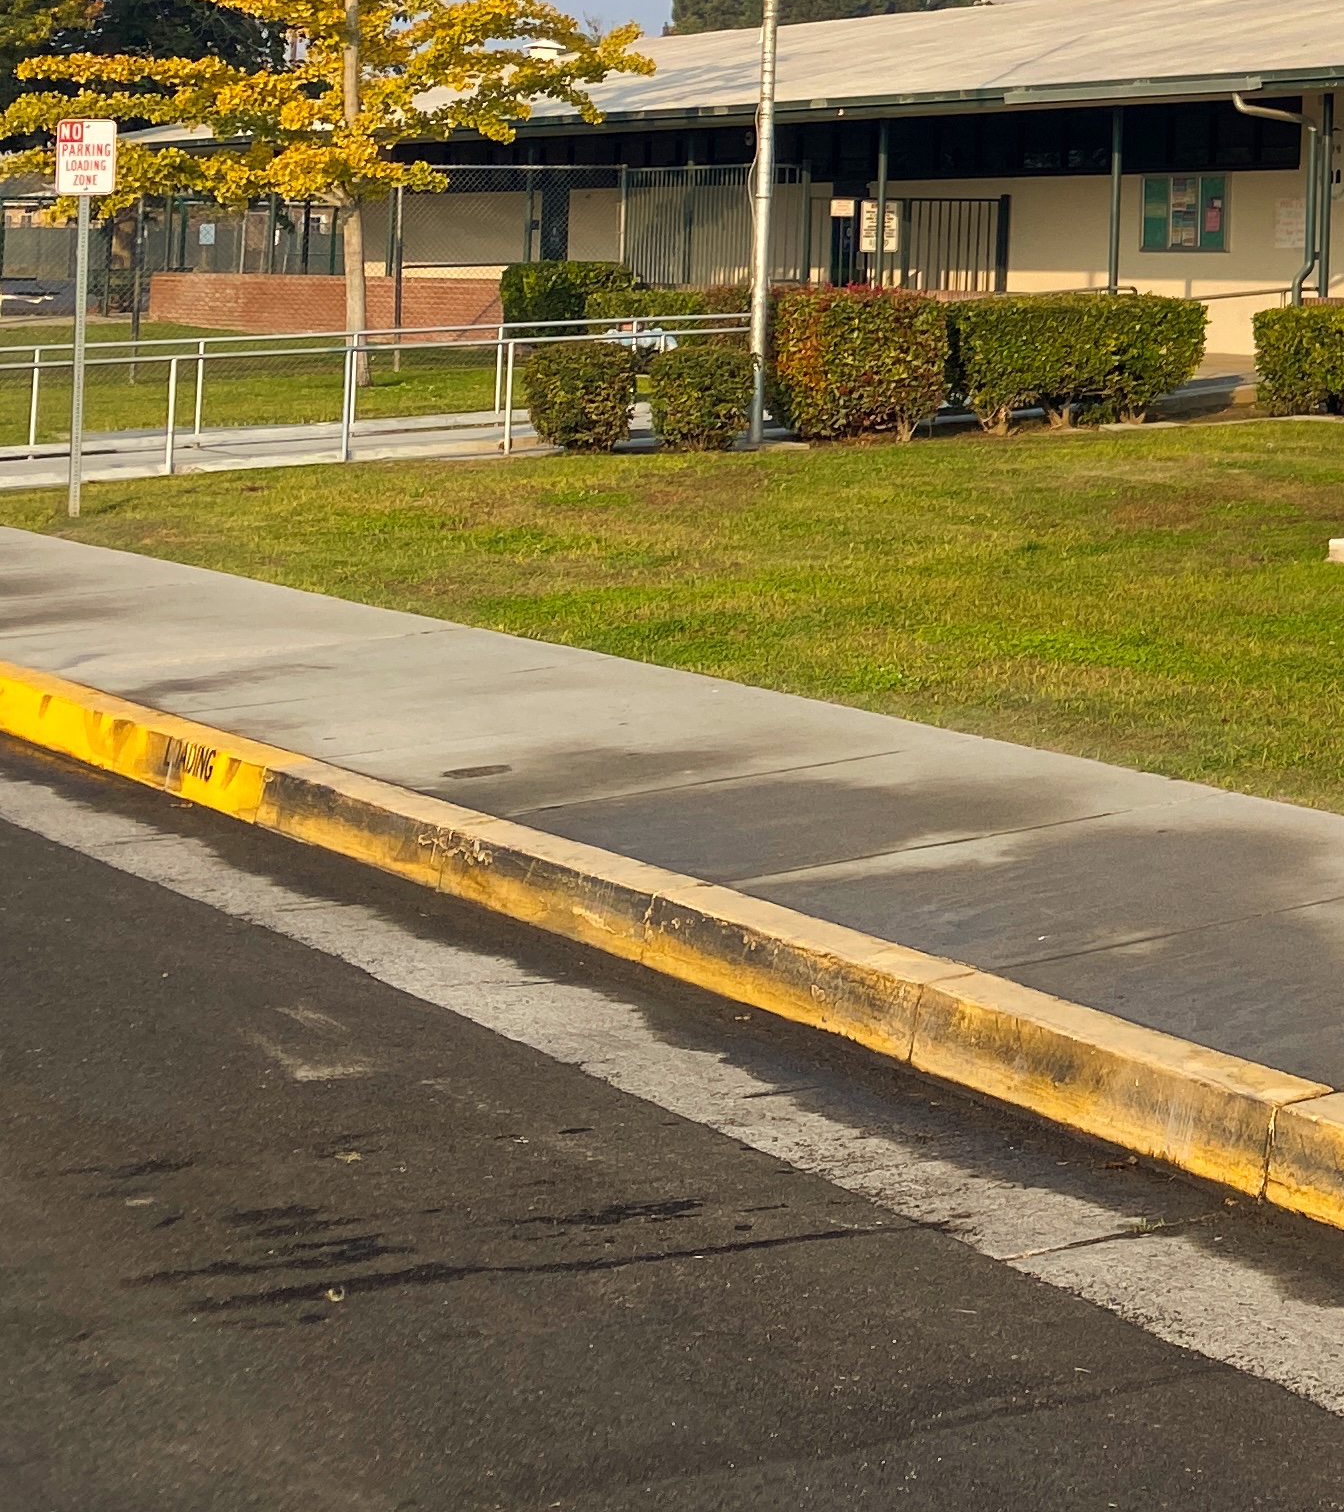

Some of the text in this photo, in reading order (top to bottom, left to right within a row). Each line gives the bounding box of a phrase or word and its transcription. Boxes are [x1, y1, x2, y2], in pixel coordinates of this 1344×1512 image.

[60, 123, 81, 140] NO
[61, 143, 112, 157] PARKING
[66, 160, 107, 172] LOADING
[73, 174, 98, 186] ZONE
